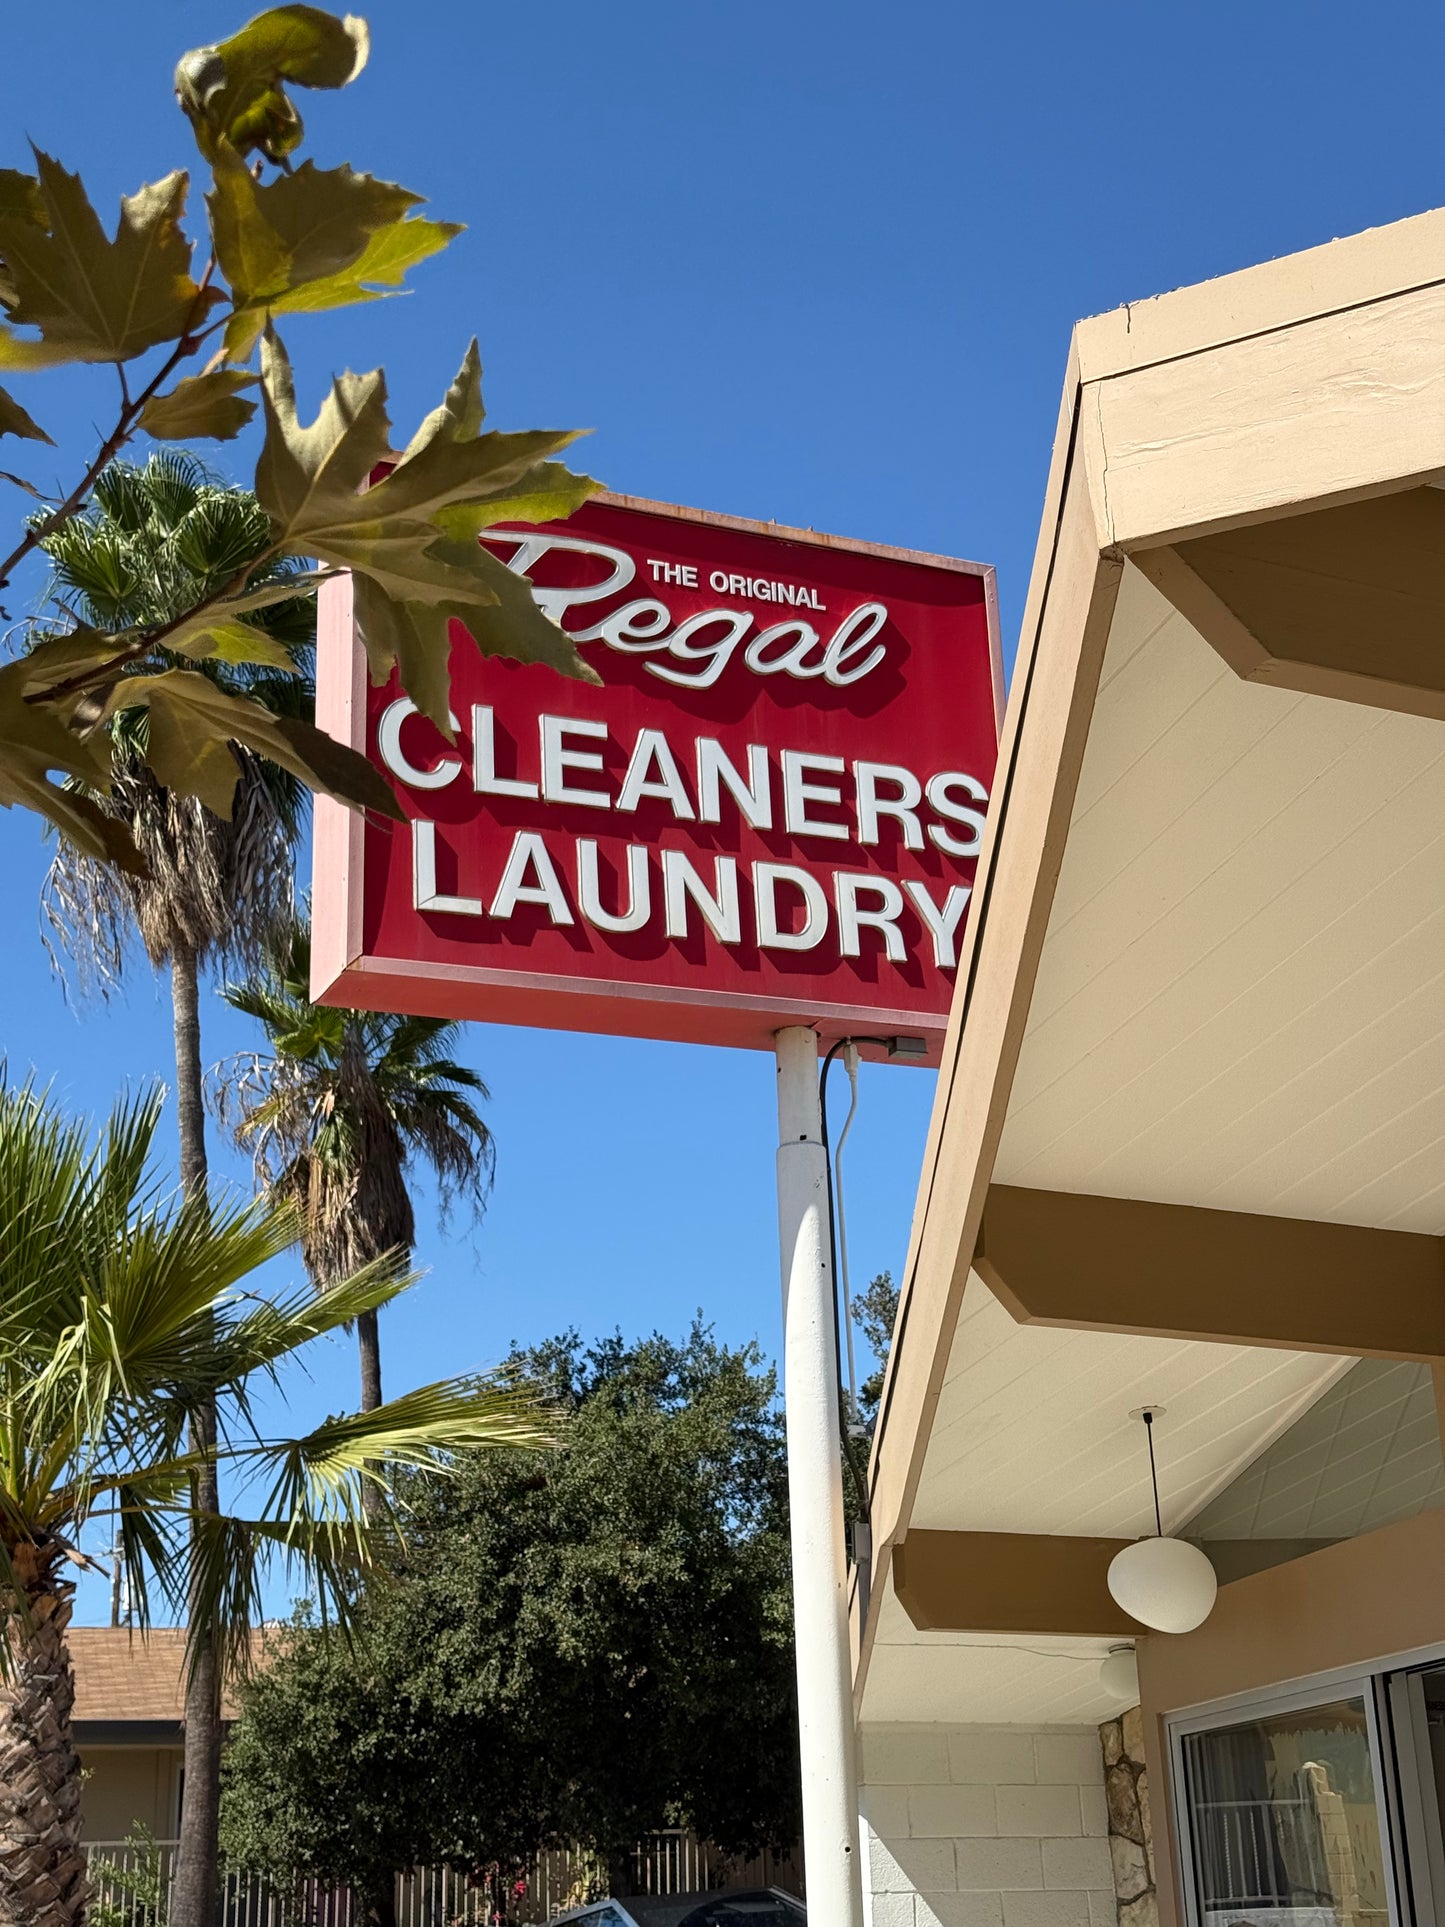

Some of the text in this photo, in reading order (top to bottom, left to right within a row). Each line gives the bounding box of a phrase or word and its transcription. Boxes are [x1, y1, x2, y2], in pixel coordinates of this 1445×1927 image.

[479, 531, 887, 689] Regal
[647, 558, 826, 611] THE ORIGINAL
[378, 696, 989, 857] CLEANERS
[411, 818, 972, 969] LAUNDRY
